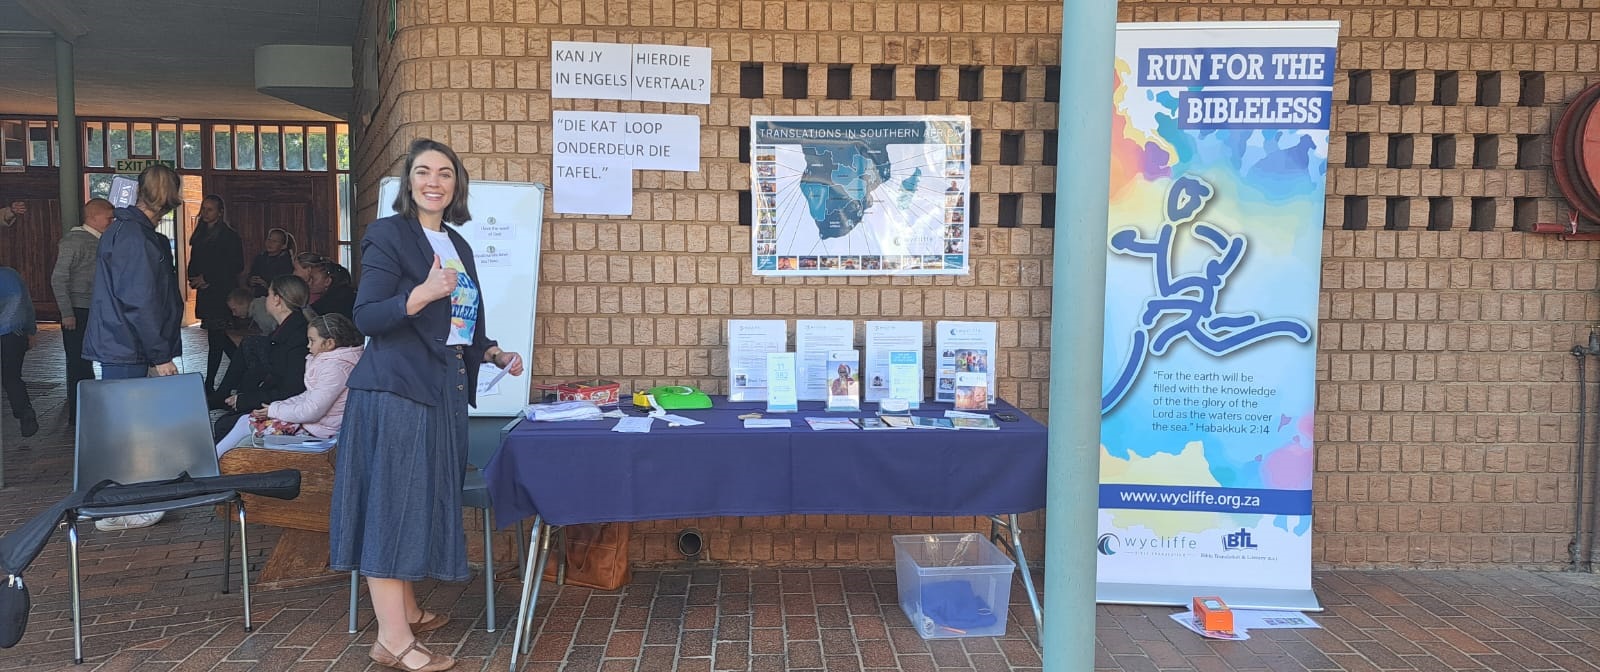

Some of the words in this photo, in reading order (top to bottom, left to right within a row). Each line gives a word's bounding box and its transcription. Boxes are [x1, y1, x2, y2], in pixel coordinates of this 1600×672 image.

[556, 50, 584, 62] KAN
[588, 51, 602, 63] JY
[636, 52, 690, 67] HIERDIE
[1146, 54, 1204, 80] RUN
[1210, 54, 1264, 80] FOR
[1272, 53, 1326, 80] THE
[556, 72, 570, 85] IN
[575, 73, 627, 86] ENGELS
[636, 76, 704, 91] VERTAAL?
[1186, 97, 1322, 124] BIBLELESS
[591, 120, 616, 132] KAT
[625, 122, 662, 134] LOOP
[760, 128, 842, 138] TRANSLATIONS
[846, 128, 856, 138] IN
[860, 128, 920, 138] SOUTHERN
[557, 142, 644, 157] ONDERDEUR
[649, 145, 670, 157] DIE
[117, 160, 144, 171] EXIT
[1176, 372, 1191, 380] the
[1194, 372, 1220, 381] earth
[1222, 372, 1239, 382] will
[1241, 373, 1254, 382] be
[1154, 384, 1176, 393] filled
[1179, 384, 1200, 393] with
[1202, 385, 1218, 394] the
[1221, 386, 1276, 397] knowledge
[1153, 397, 1162, 405] of
[1165, 397, 1181, 406] the
[1184, 398, 1200, 406] the
[1202, 398, 1226, 408] glory
[1229, 399, 1239, 408] of
[1242, 399, 1258, 408] the
[1153, 409, 1174, 419] Lord
[1190, 410, 1206, 419] the
[1208, 412, 1242, 421] waters
[1244, 413, 1272, 422] cover
[1152, 422, 1168, 432] the
[1196, 423, 1247, 433] Habakkuk
[1250, 424, 1270, 434] 2:14
[1120, 490, 1260, 508] www.wycliffe.org.za
[1124, 536, 1197, 550] wycliffe
